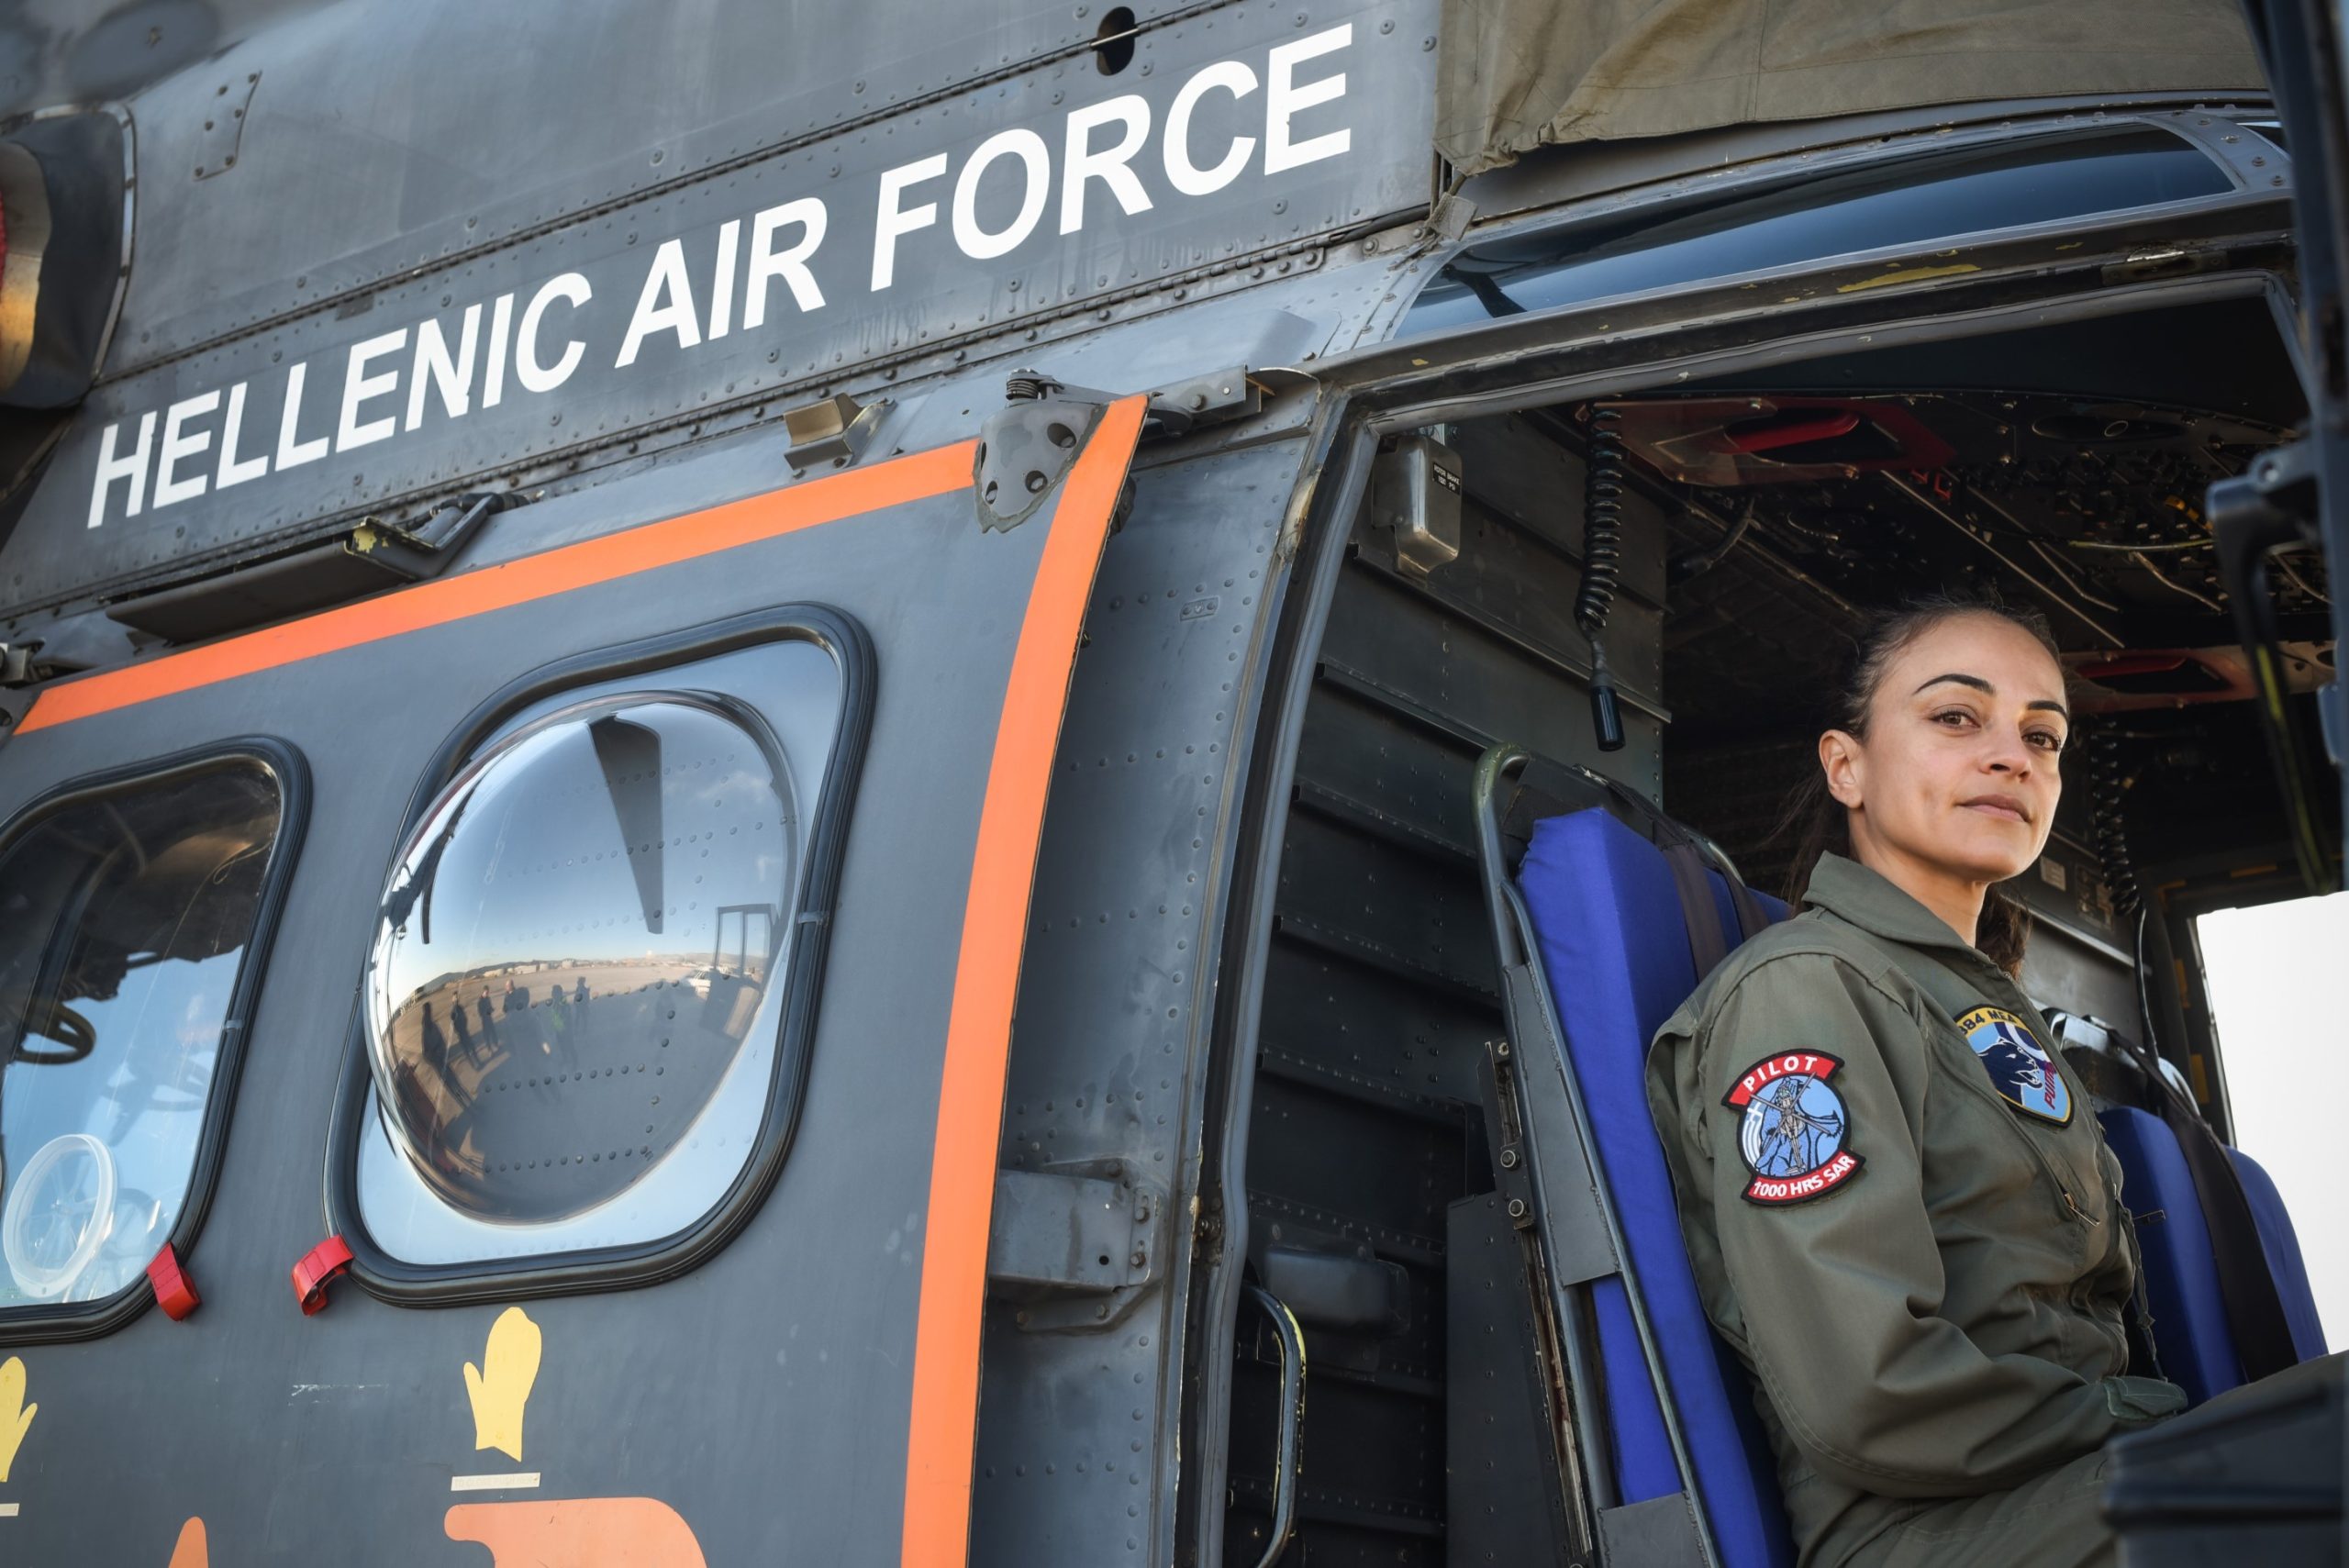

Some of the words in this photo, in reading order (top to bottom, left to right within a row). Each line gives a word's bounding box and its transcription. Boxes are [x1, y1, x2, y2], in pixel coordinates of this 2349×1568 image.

[88, 272, 592, 528] HELLENIC
[614, 197, 828, 369] AIR
[871, 22, 1353, 292] FORCE
[1743, 1056, 1818, 1092] PILOT
[1753, 1181, 1787, 1197] 1000
[1789, 1174, 1824, 1195] HRS
[1822, 1154, 1855, 1183] SAR
